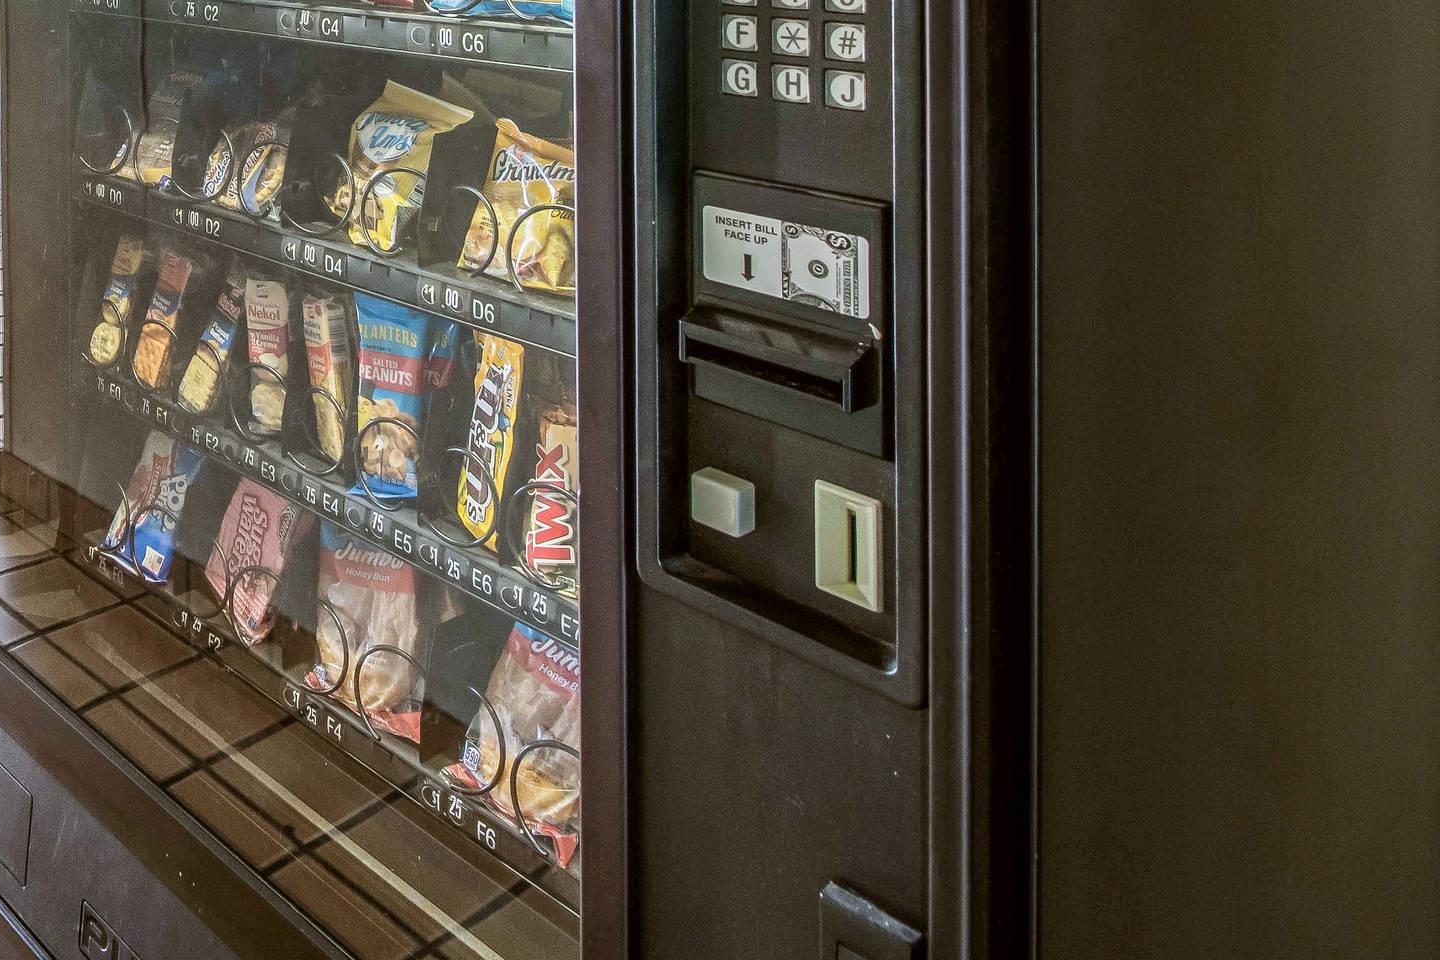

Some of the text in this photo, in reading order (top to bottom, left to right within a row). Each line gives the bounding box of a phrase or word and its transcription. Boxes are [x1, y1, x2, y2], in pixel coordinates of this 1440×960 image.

[204, 5, 219, 21] C2
[321, 19, 339, 36] C4
[736, 22, 749, 45] F
[462, 31, 484, 53] C6
[838, 31, 856, 55] #
[734, 67, 750, 90] G
[785, 72, 800, 97] H
[841, 79, 855, 103] J
[109, 188, 122, 205] D0
[205, 220, 220, 237] D2
[715, 215, 778, 236] INSERT BILL
[724, 229, 768, 246] FACE UP
[324, 254, 342, 276] D4
[472, 301, 495, 324] D6
[359, 324, 418, 348] PLANTERS
[359, 362, 414, 388] PEANUTS
[373, 359, 399, 369] SALTED
[109, 385, 121, 401] E0
[156, 407, 168, 424] E1
[205, 433, 219, 452] E2
[261, 461, 276, 482] E3
[323, 491, 339, 513] E4
[394, 531, 412, 553] E5
[373, 572, 390, 584] Bun
[472, 567, 492, 596] E6
[208, 632, 221, 655] F2
[539, 663, 569, 686] Honey
[326, 714, 343, 742] F4
[476, 820, 496, 851] F6
